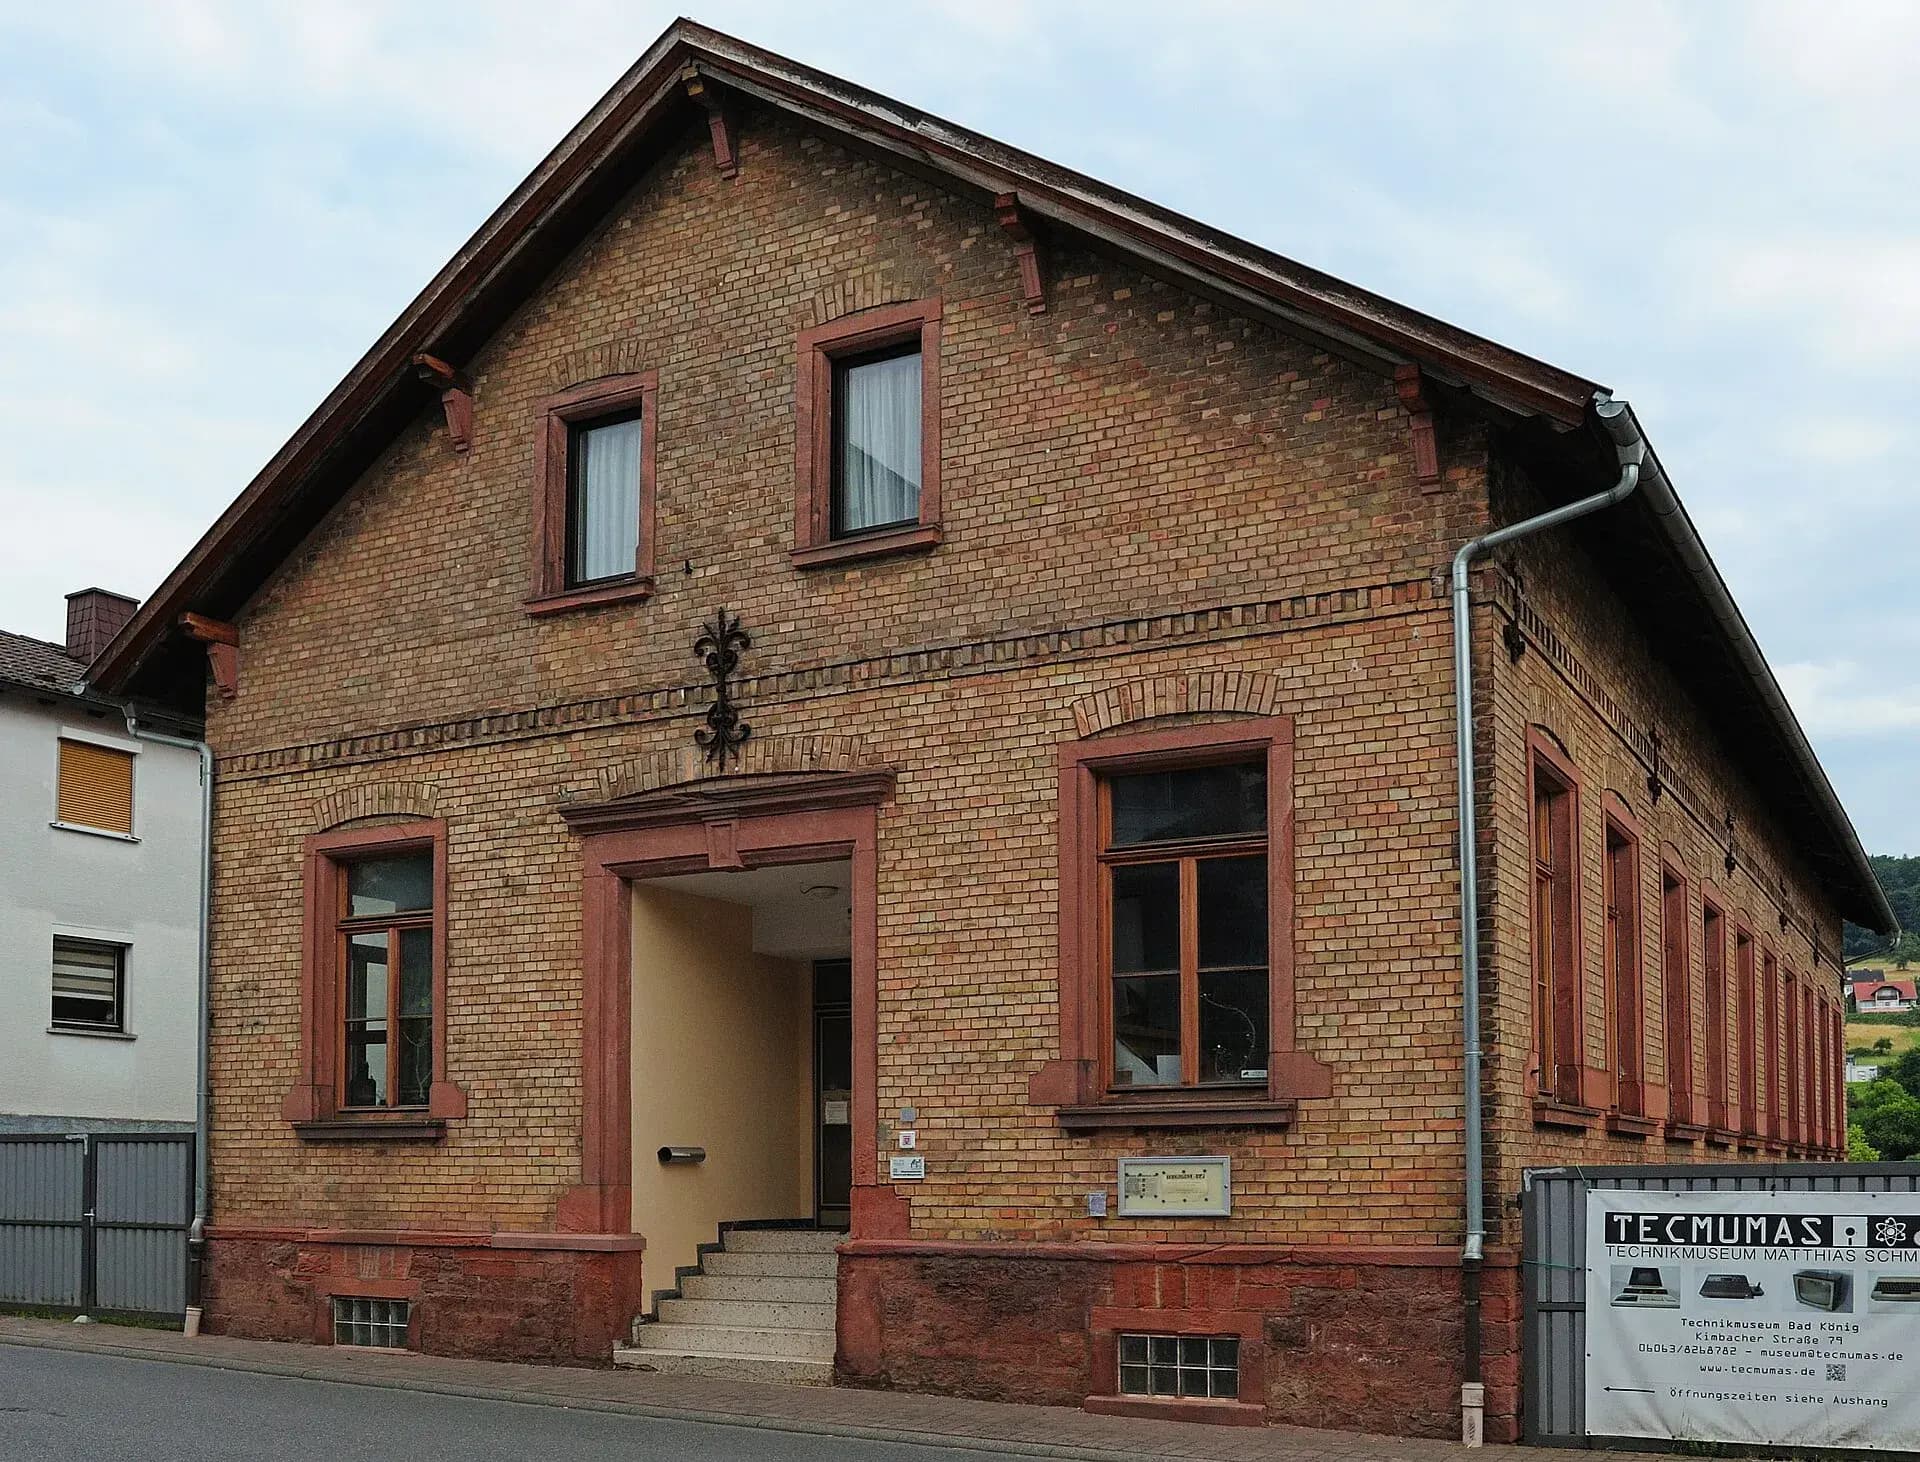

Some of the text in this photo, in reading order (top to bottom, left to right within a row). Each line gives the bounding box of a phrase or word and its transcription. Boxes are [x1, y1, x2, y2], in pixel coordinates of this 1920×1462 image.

[1613, 1214, 1822, 1246] TECMUMAS
[1606, 1245, 1756, 1260] TECHNIKMUSEUM
[1764, 1248, 1856, 1262] MATTHIAS
[1681, 1318, 1859, 1334] Technikmuseum Bad König
[1695, 1331, 1843, 1346] Kimbacher Straße 79
[1638, 1343, 1737, 1356] 06063/8268782
[1760, 1349, 1903, 1361] museum@tecmumas.de
[1699, 1364, 1816, 1377] www.tecmumas.de
[1670, 1386, 1888, 1408] Öffnungszeiten siehe Aushang
